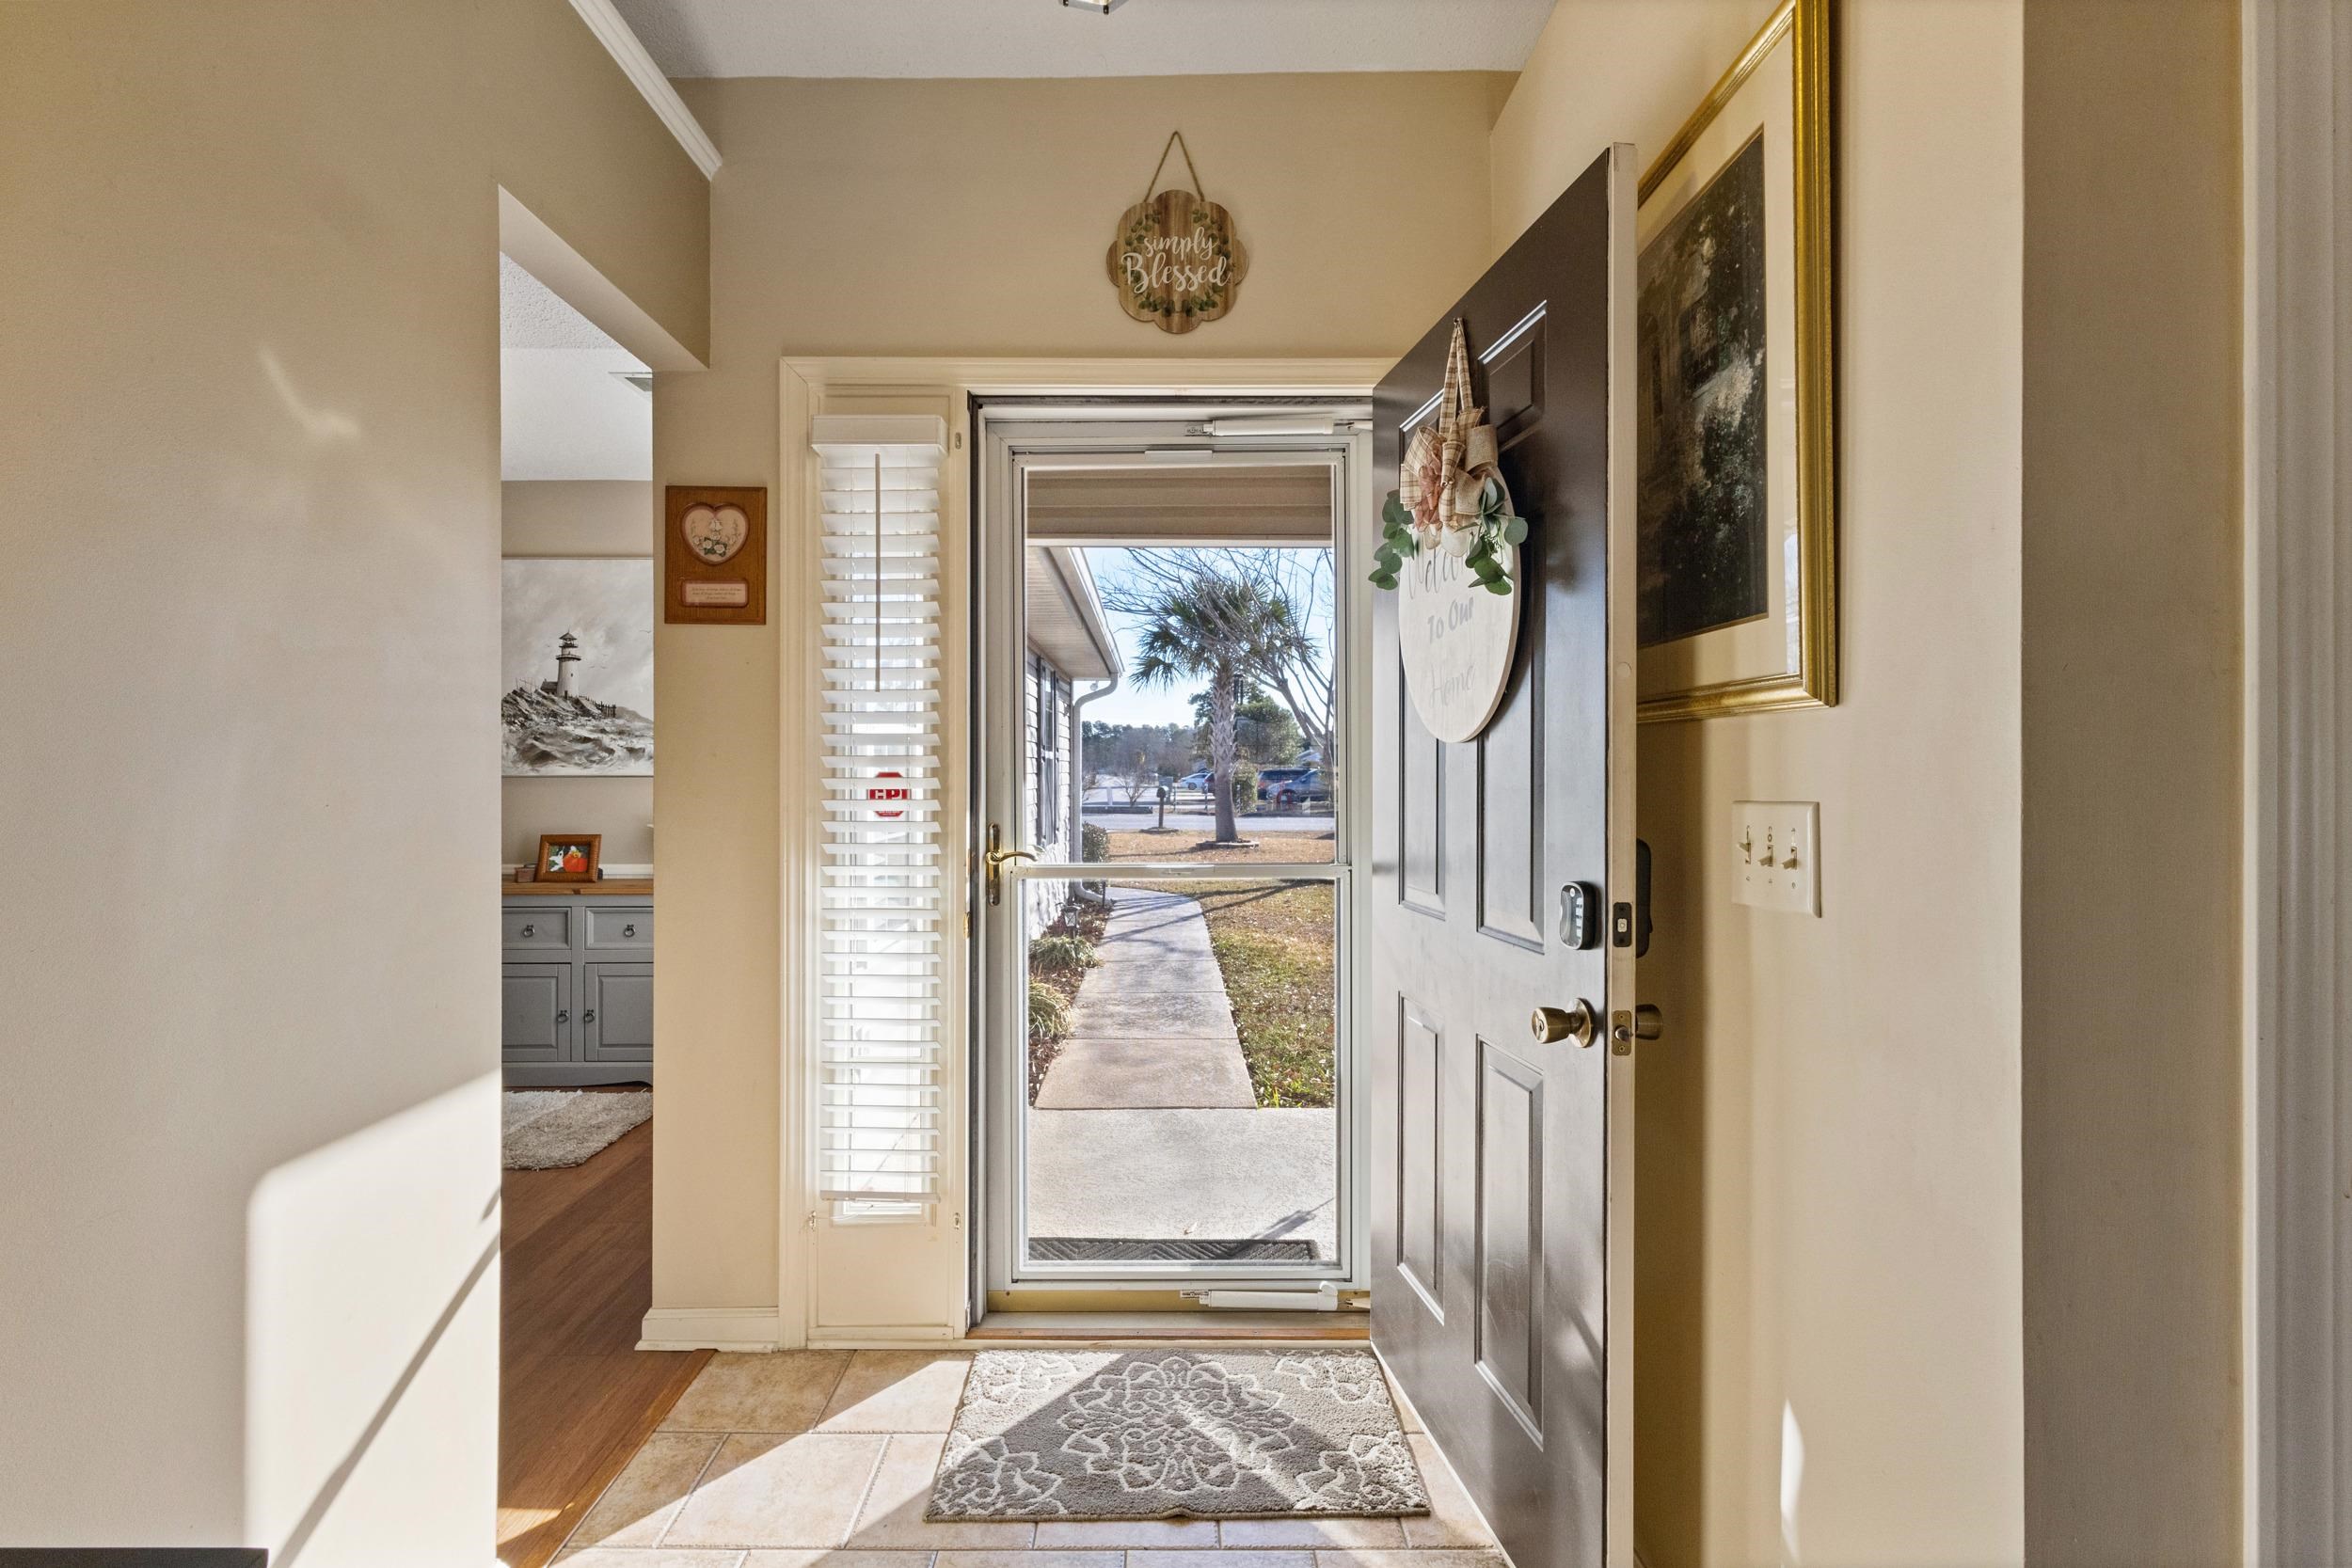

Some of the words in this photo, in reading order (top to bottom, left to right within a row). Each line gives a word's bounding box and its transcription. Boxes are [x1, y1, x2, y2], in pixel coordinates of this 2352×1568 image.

[1143, 227, 1217, 260] simply
[1120, 252, 1232, 293] Blessed
[1448, 596, 1474, 631] Our
